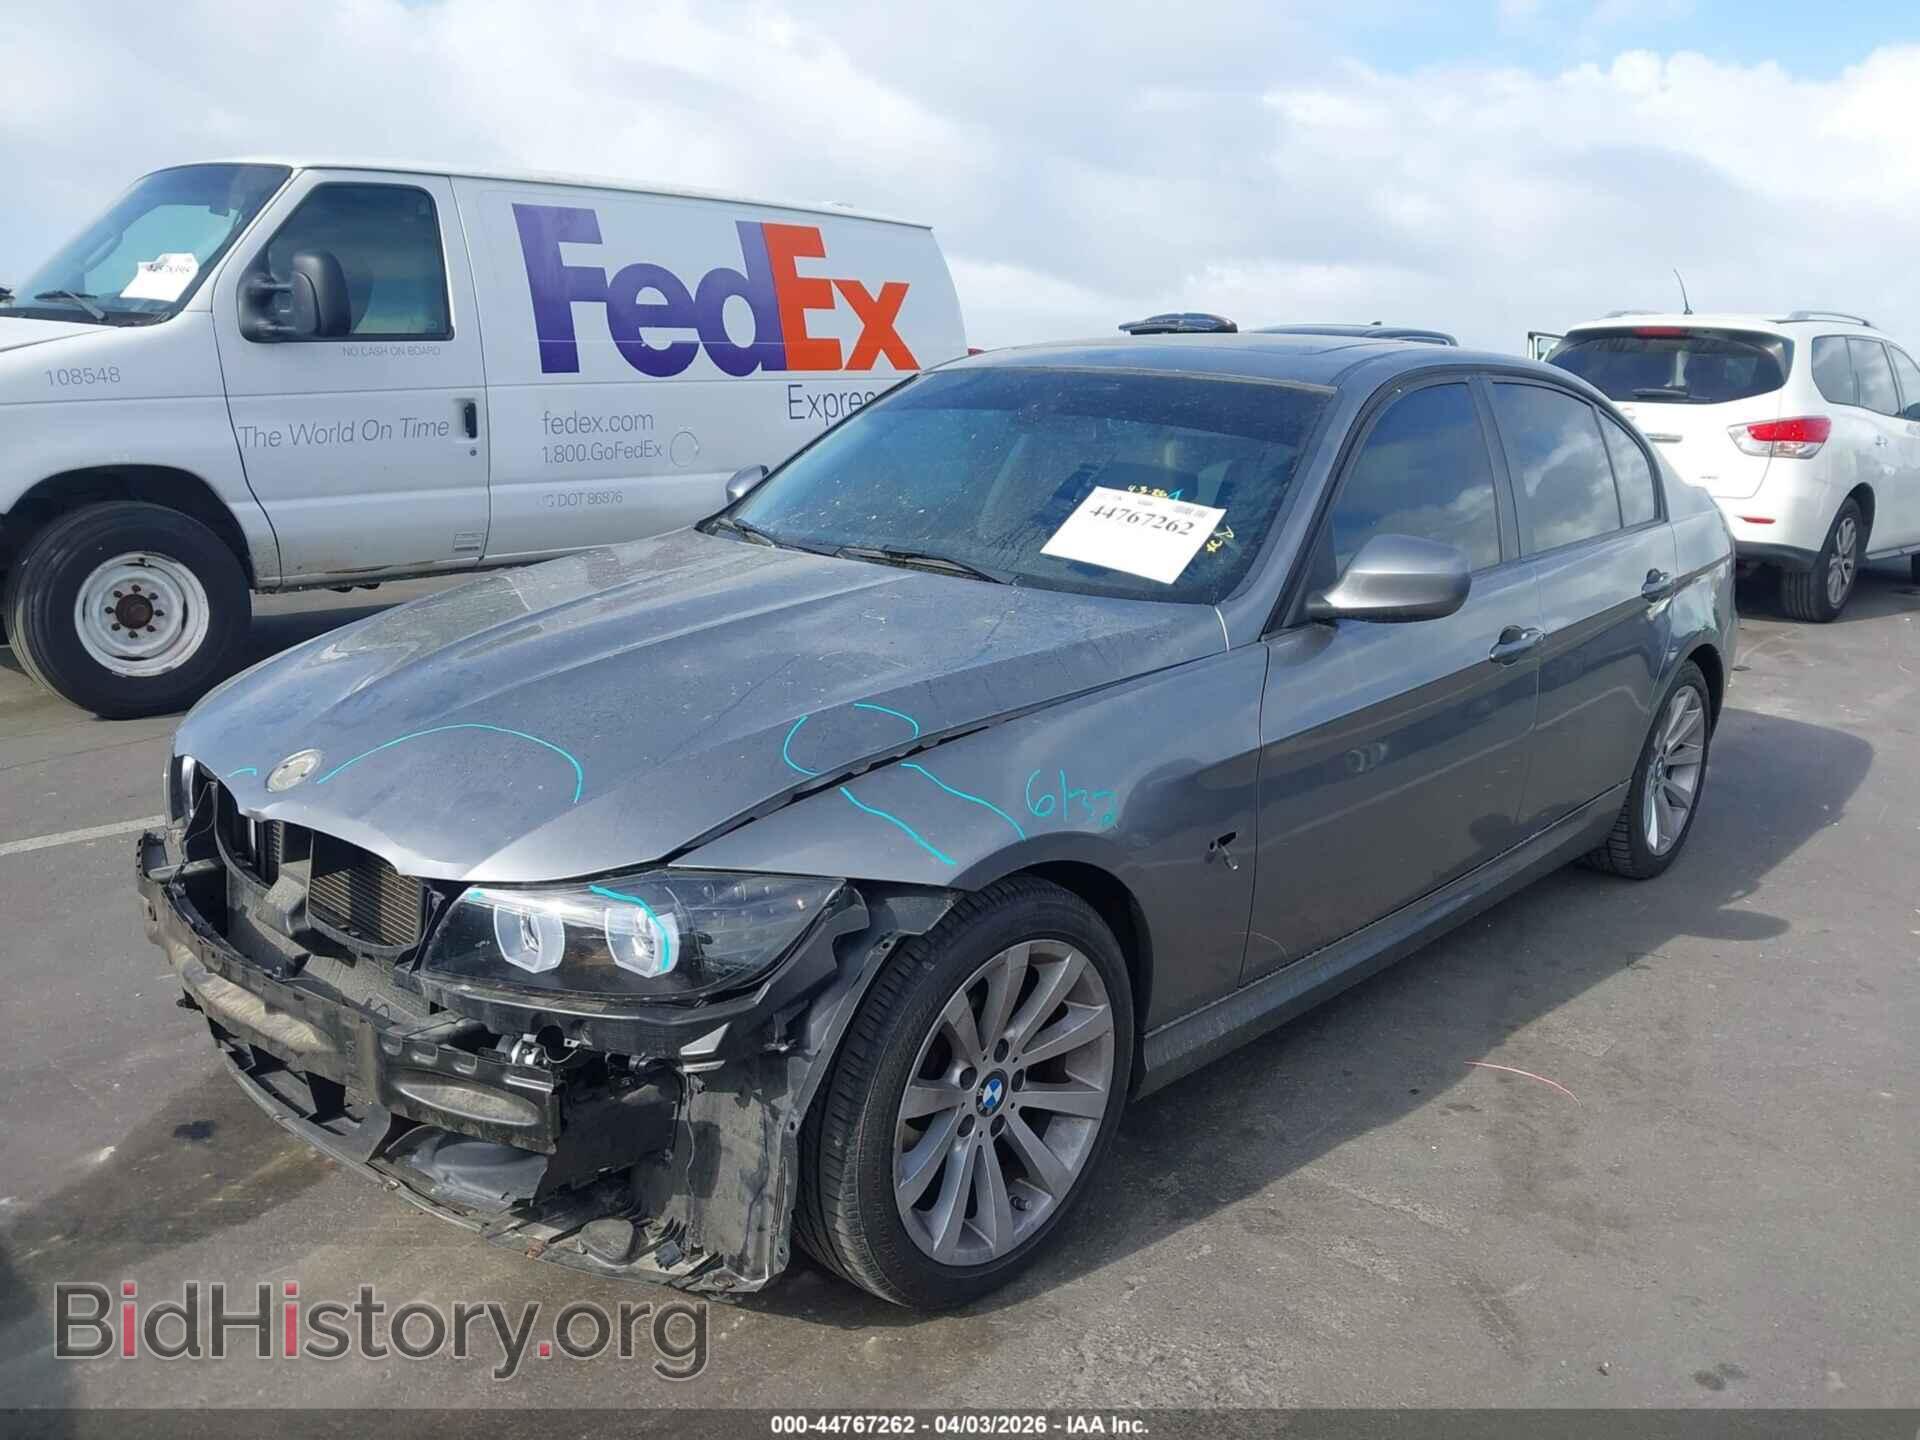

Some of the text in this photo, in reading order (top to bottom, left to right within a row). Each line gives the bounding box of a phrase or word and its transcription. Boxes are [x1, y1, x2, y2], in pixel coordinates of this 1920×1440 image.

[512, 203, 921, 378] FedEx
[45, 367, 121, 385] 108548
[237, 416, 450, 448] The World On Time
[541, 410, 654, 436] fedex.com
[542, 439, 663, 464] 1.800.GoFedEx
[1089, 504, 1195, 536] 44767262
